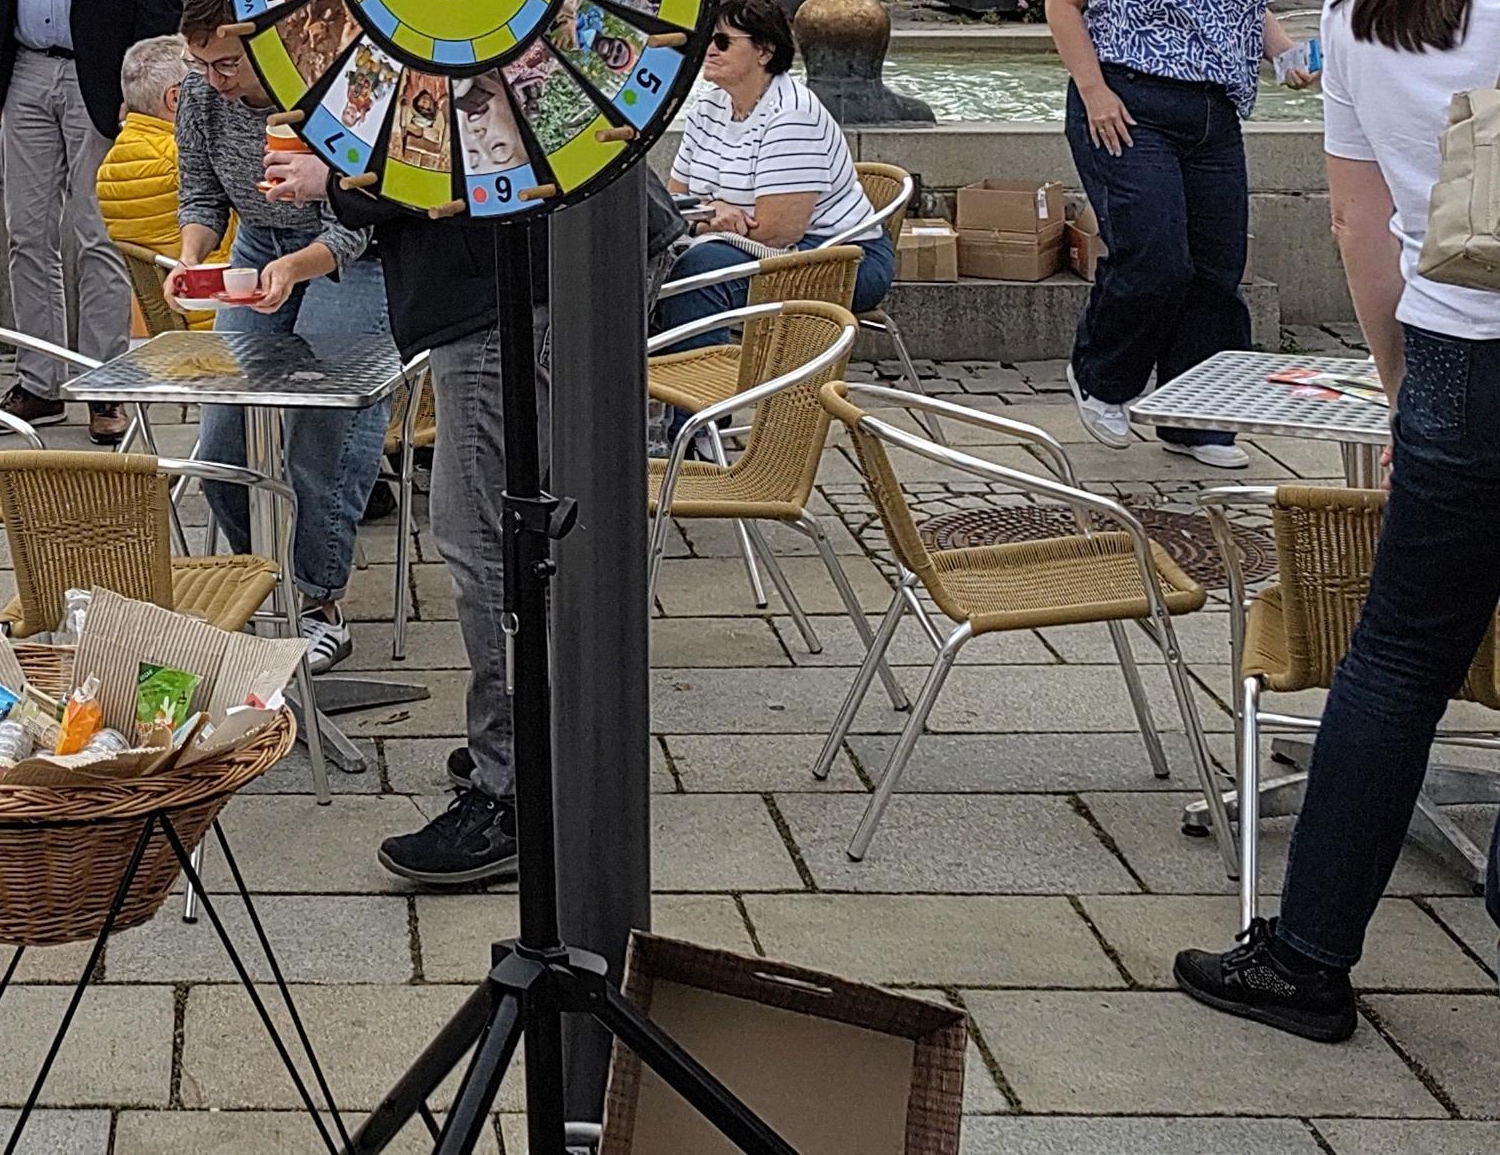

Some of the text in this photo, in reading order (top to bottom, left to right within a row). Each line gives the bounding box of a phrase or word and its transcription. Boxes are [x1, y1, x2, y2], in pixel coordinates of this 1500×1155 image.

[636, 67, 662, 96] 5
[324, 131, 348, 156] 7
[495, 175, 513, 203] 6
